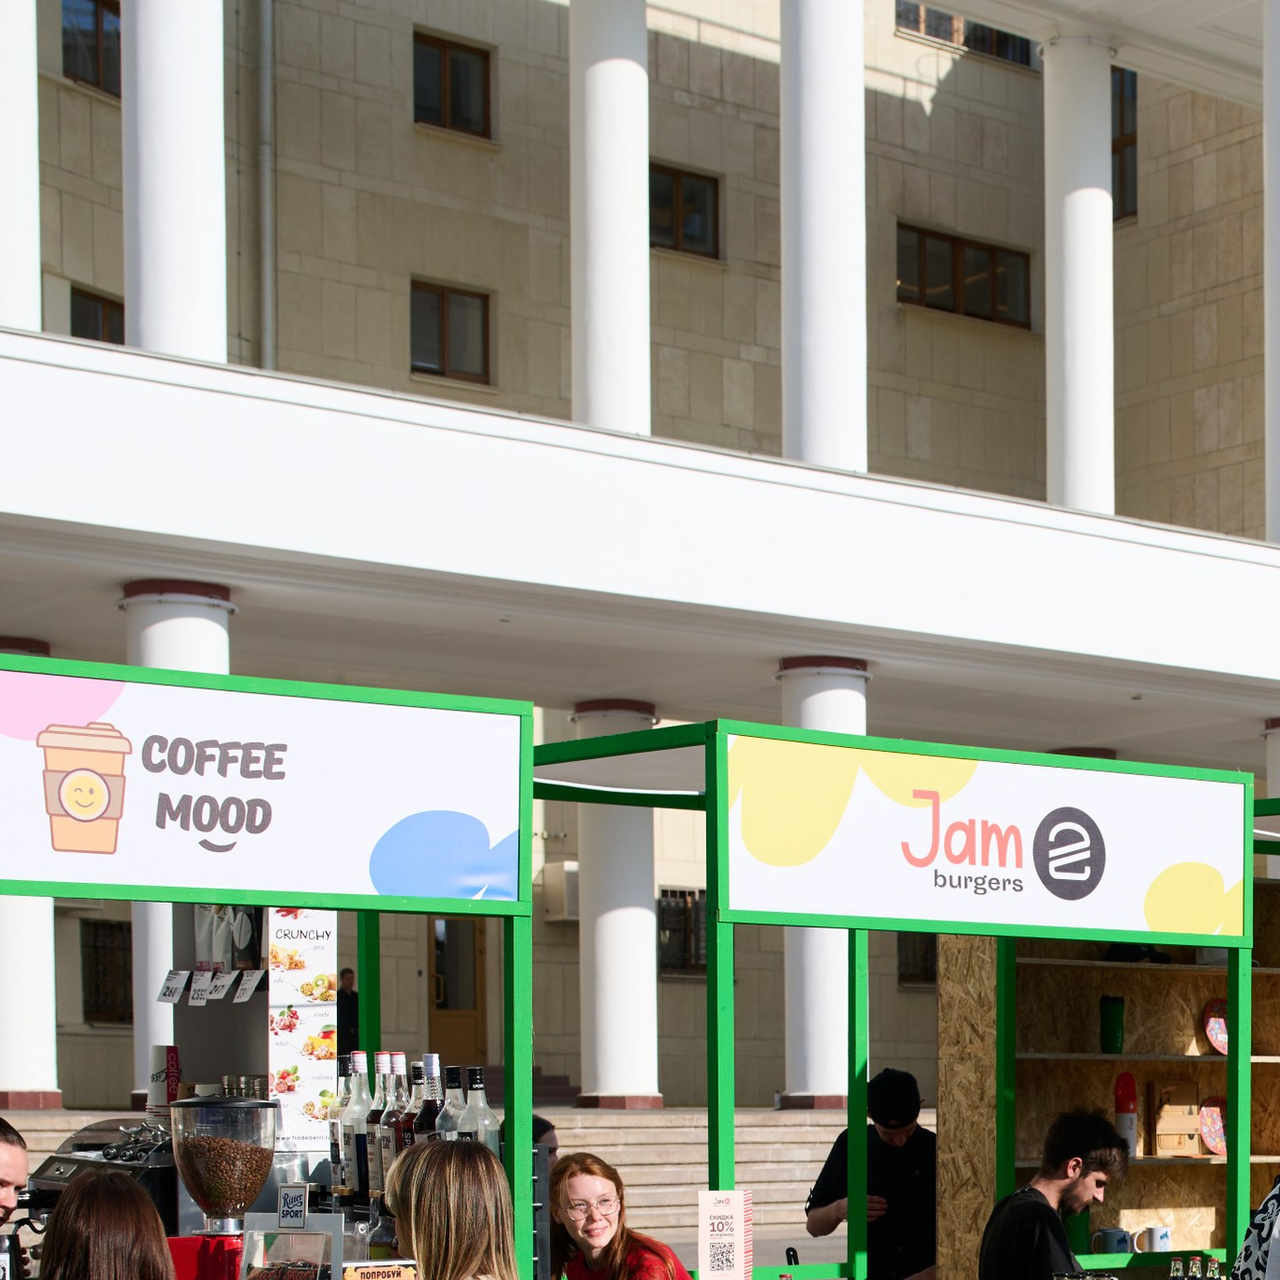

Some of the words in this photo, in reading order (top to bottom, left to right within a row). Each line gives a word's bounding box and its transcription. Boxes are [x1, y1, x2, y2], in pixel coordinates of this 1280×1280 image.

[141, 735, 288, 781] COFFEE
[156, 793, 272, 835] MOOD
[901, 789, 1023, 868] Jam
[934, 869, 1024, 895] burgers
[275, 928, 332, 941] CRUNCHY
[168, 1053, 178, 1094] coffee
[282, 1193, 303, 1209] Ritter
[281, 1209, 303, 1219] SPORT
[710, 1221, 735, 1233] 10%
[360, 1268, 402, 1280] ПОПРОБУЙ
